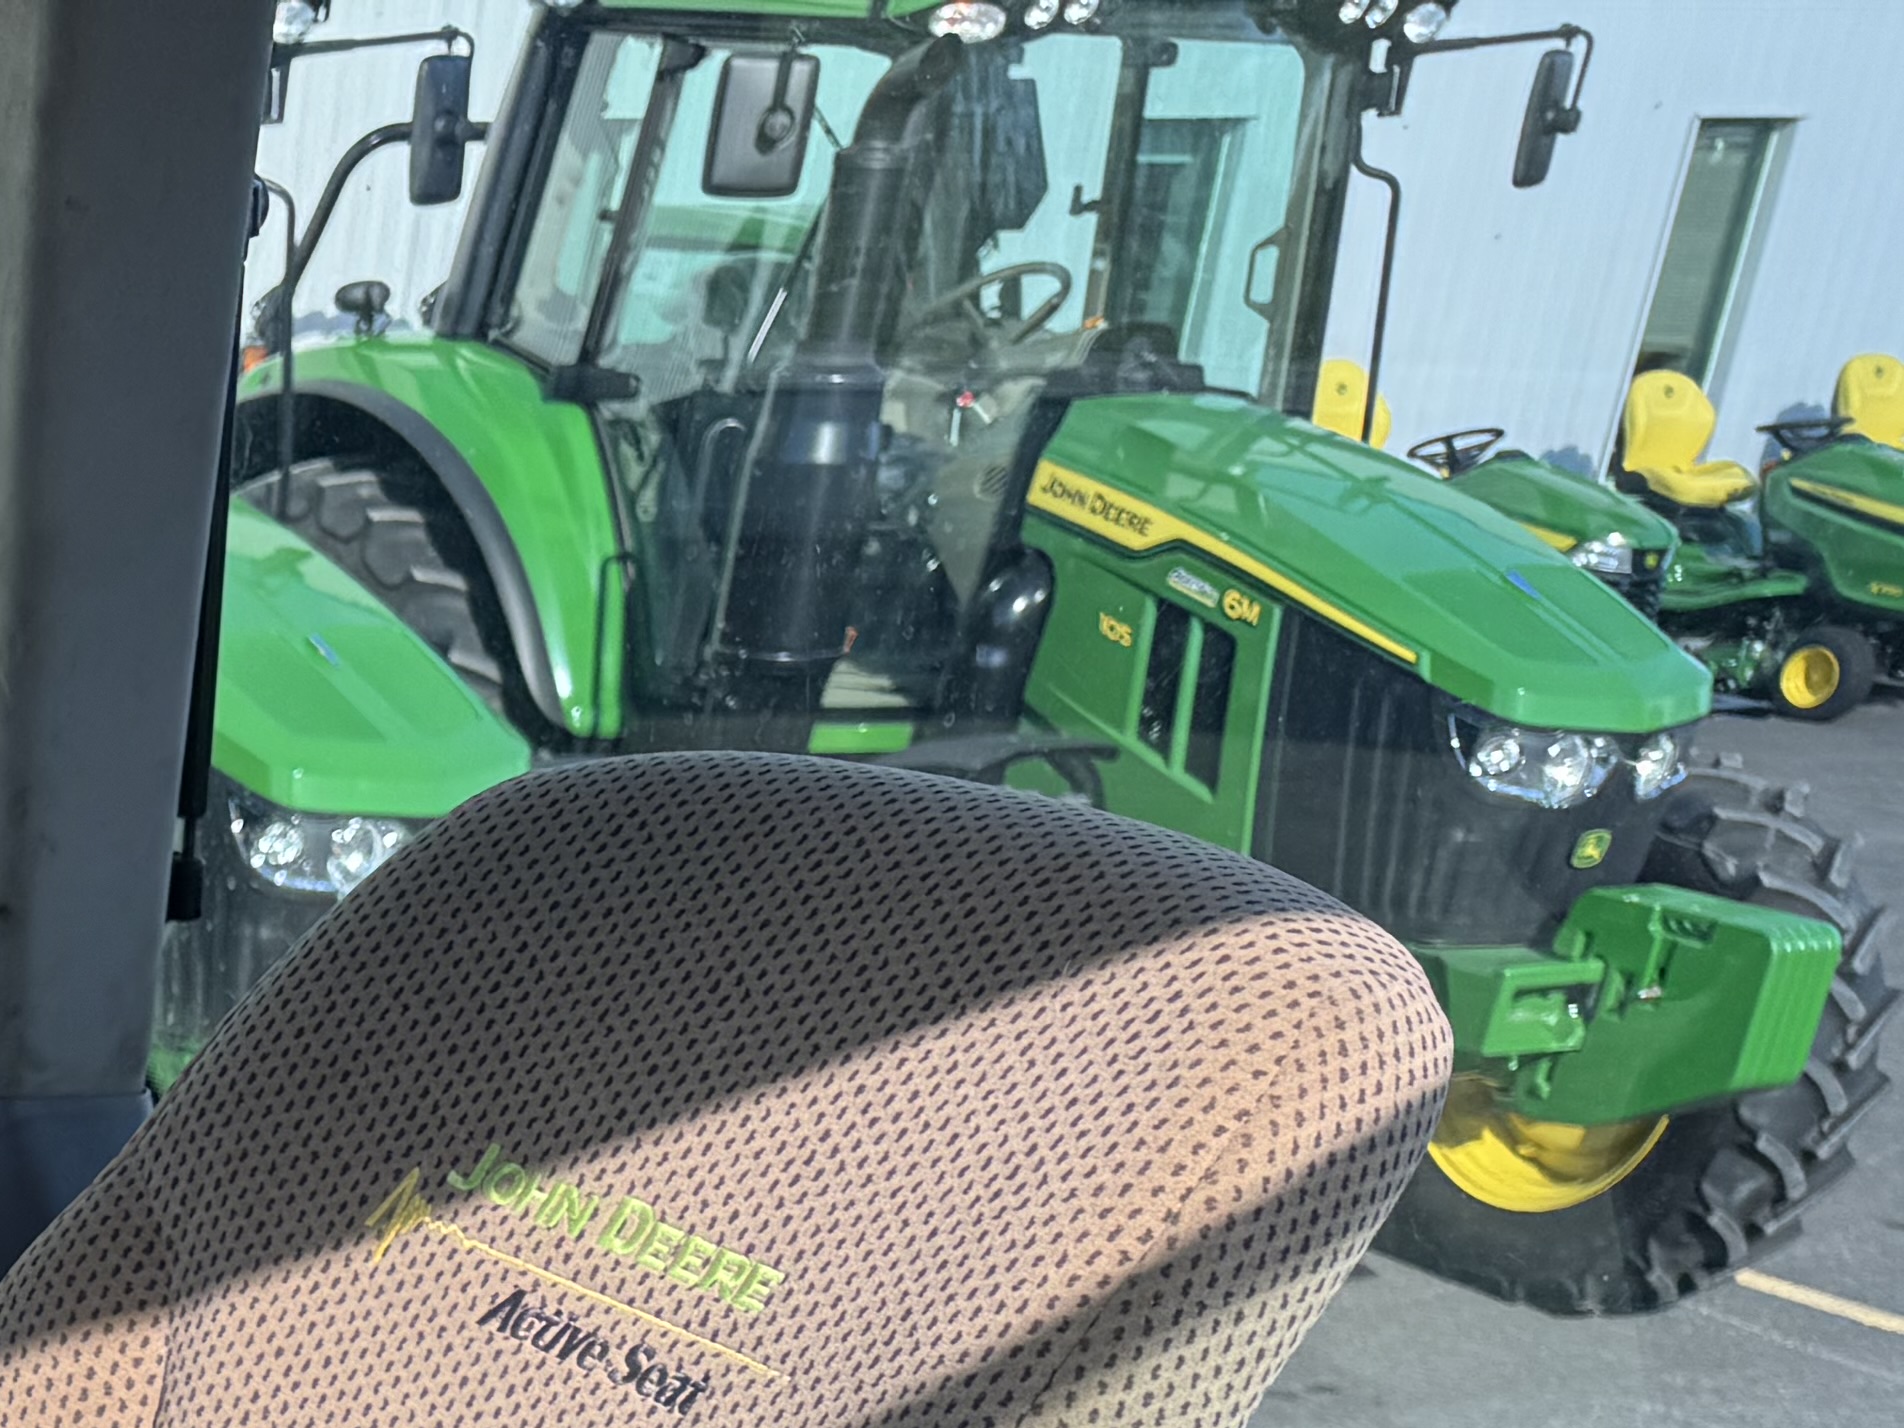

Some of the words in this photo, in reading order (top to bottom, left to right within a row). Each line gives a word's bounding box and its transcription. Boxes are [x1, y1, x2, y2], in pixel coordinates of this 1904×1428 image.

[1090, 491, 1153, 537] DEERE
[1223, 589, 1261, 626] 6M
[446, 1143, 600, 1238] JOHN
[596, 1196, 786, 1314] DEERE
[477, 1288, 610, 1372] Active
[607, 1343, 710, 1416] Seat
